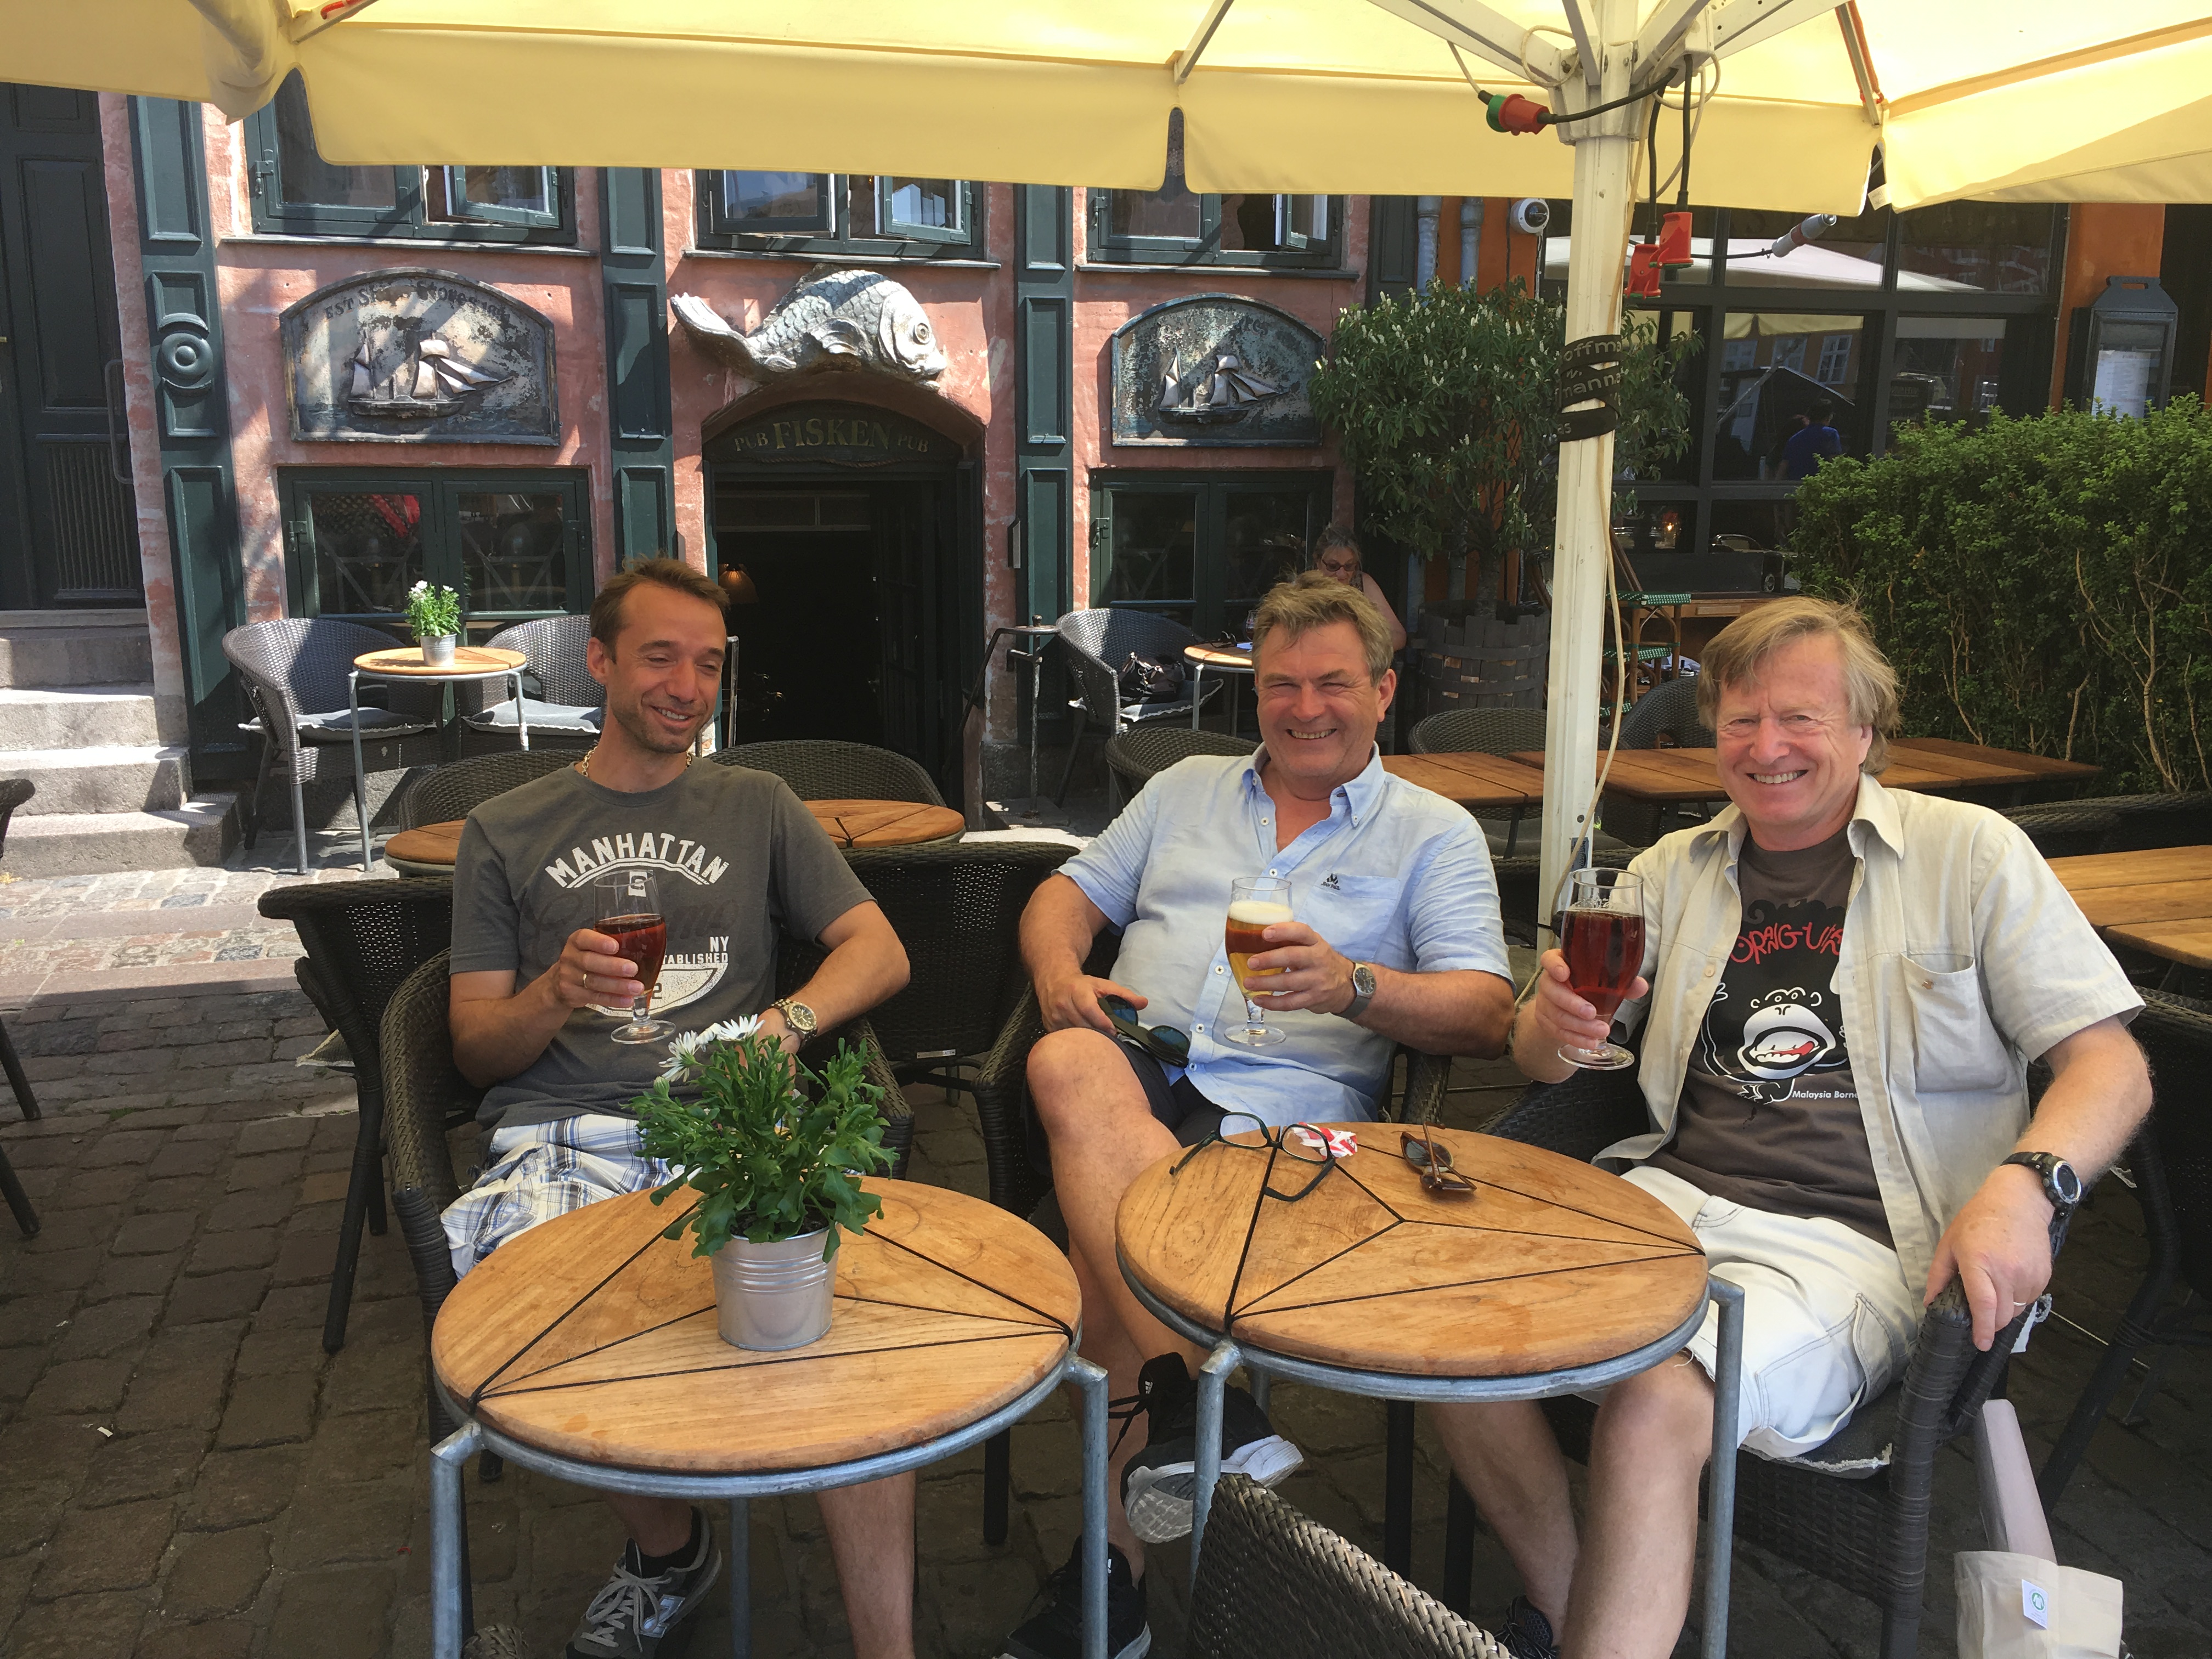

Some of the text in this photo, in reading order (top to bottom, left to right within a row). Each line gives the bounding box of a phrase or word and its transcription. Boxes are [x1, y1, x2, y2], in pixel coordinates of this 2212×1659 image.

[324, 297, 354, 319] EST
[734, 418, 929, 453] PUB FISKEN PUB
[545, 832, 730, 888] MANHATTAN
[709, 935, 730, 952] NY
[662, 952, 729, 964] TABLISHED
[1792, 1091, 1831, 1099] Malaysia
